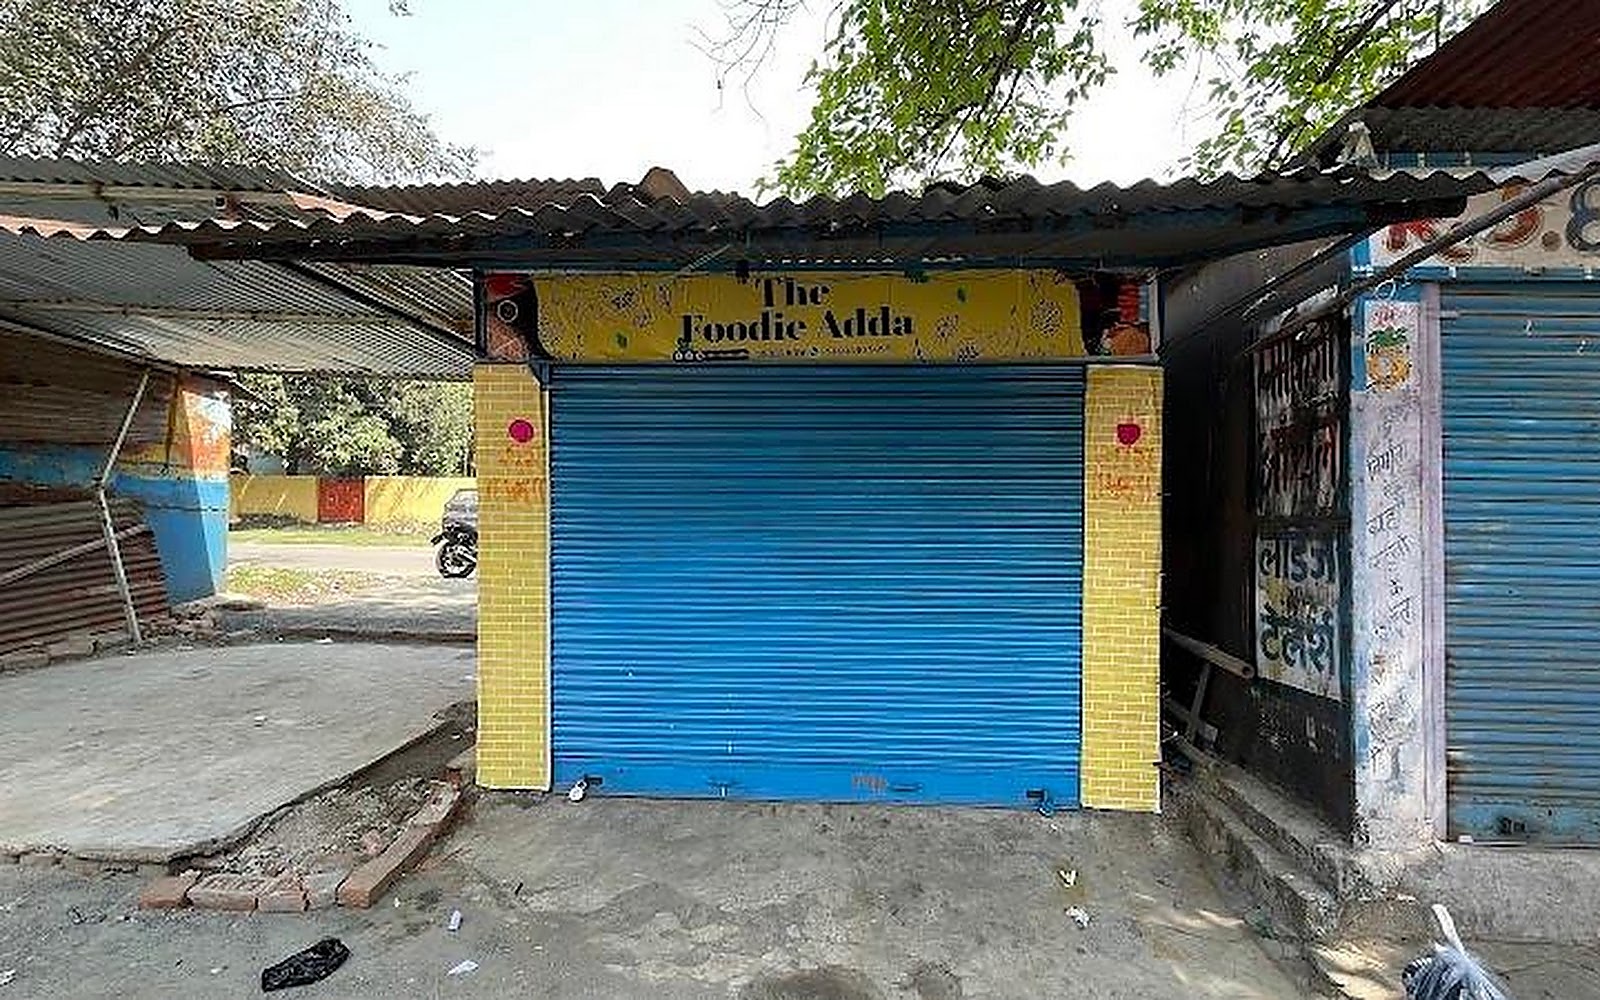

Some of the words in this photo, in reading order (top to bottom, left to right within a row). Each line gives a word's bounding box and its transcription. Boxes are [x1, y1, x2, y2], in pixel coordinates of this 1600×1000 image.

[753, 276, 829, 307] The
[678, 311, 807, 342] Foodie
[818, 305, 913, 338] Adda
